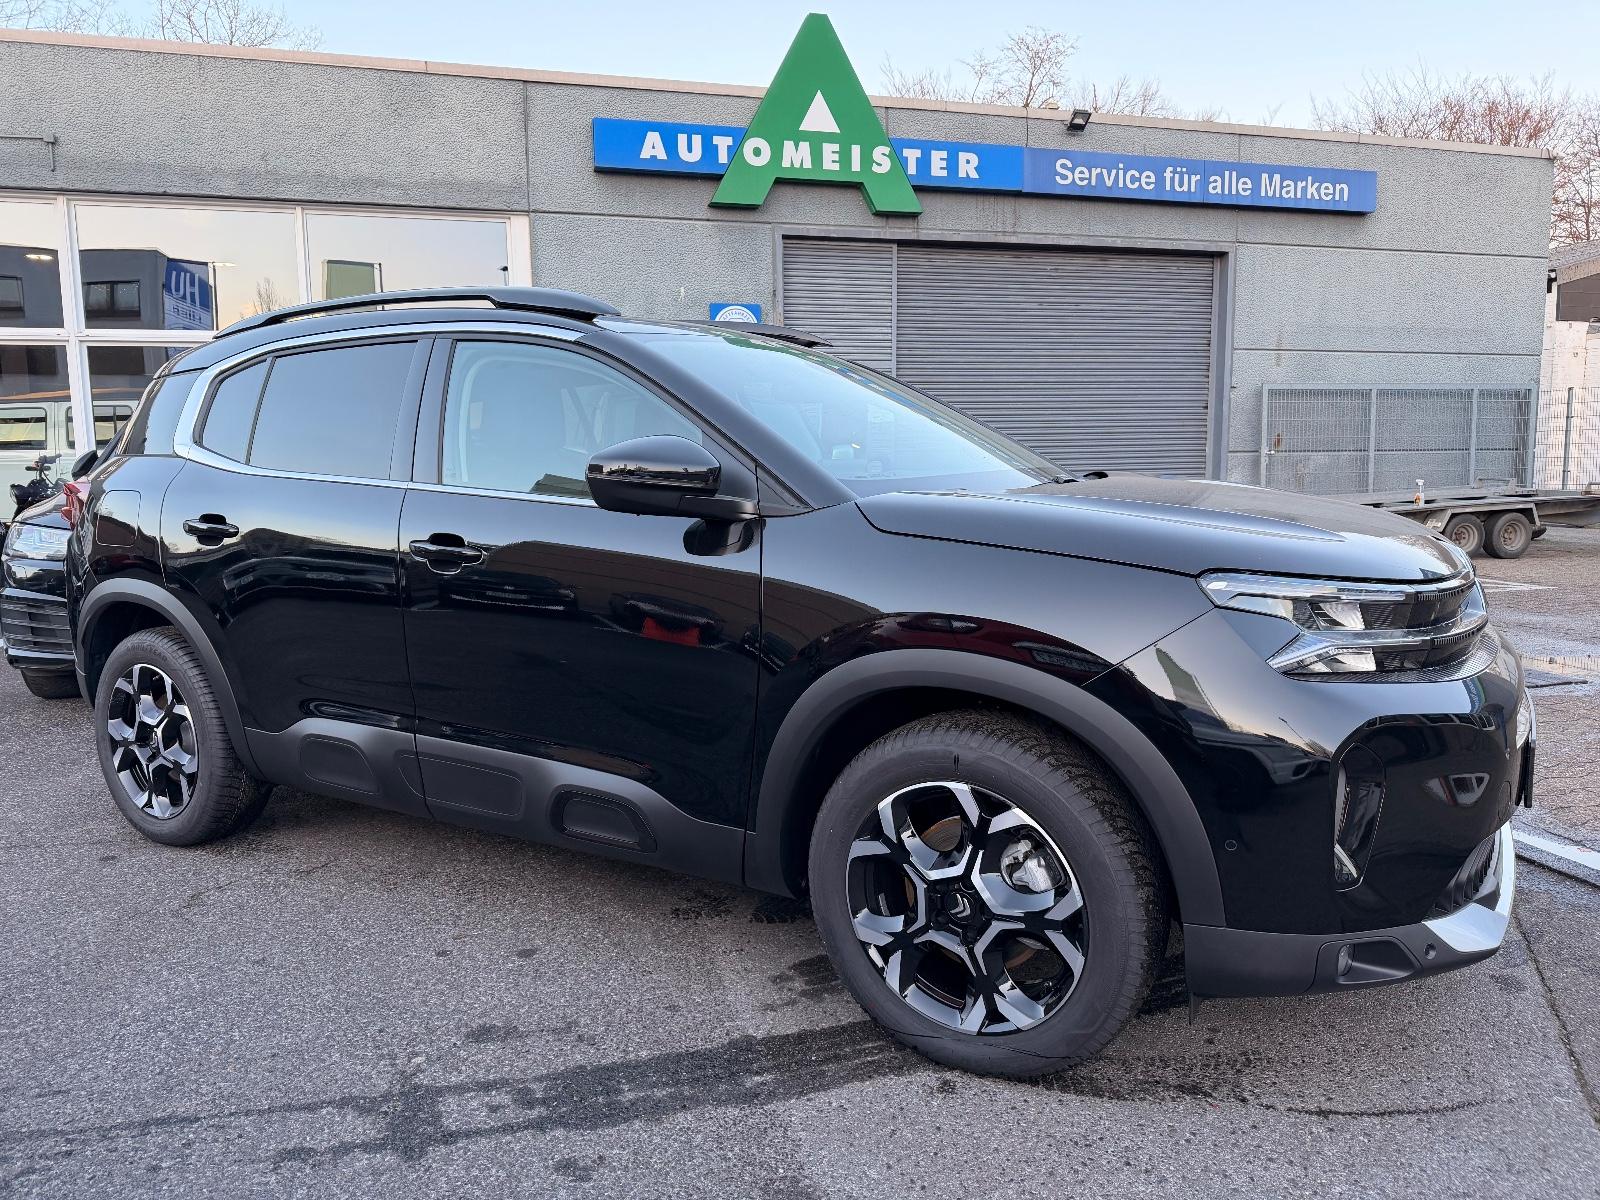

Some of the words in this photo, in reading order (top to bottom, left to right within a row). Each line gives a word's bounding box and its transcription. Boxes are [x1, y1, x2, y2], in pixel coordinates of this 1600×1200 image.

[639, 131, 980, 179] AUTOMEISTER
[1055, 158, 1156, 191] Service
[1164, 166, 1201, 193] für
[1208, 170, 1253, 196] alle
[1260, 173, 1349, 202] Marken
